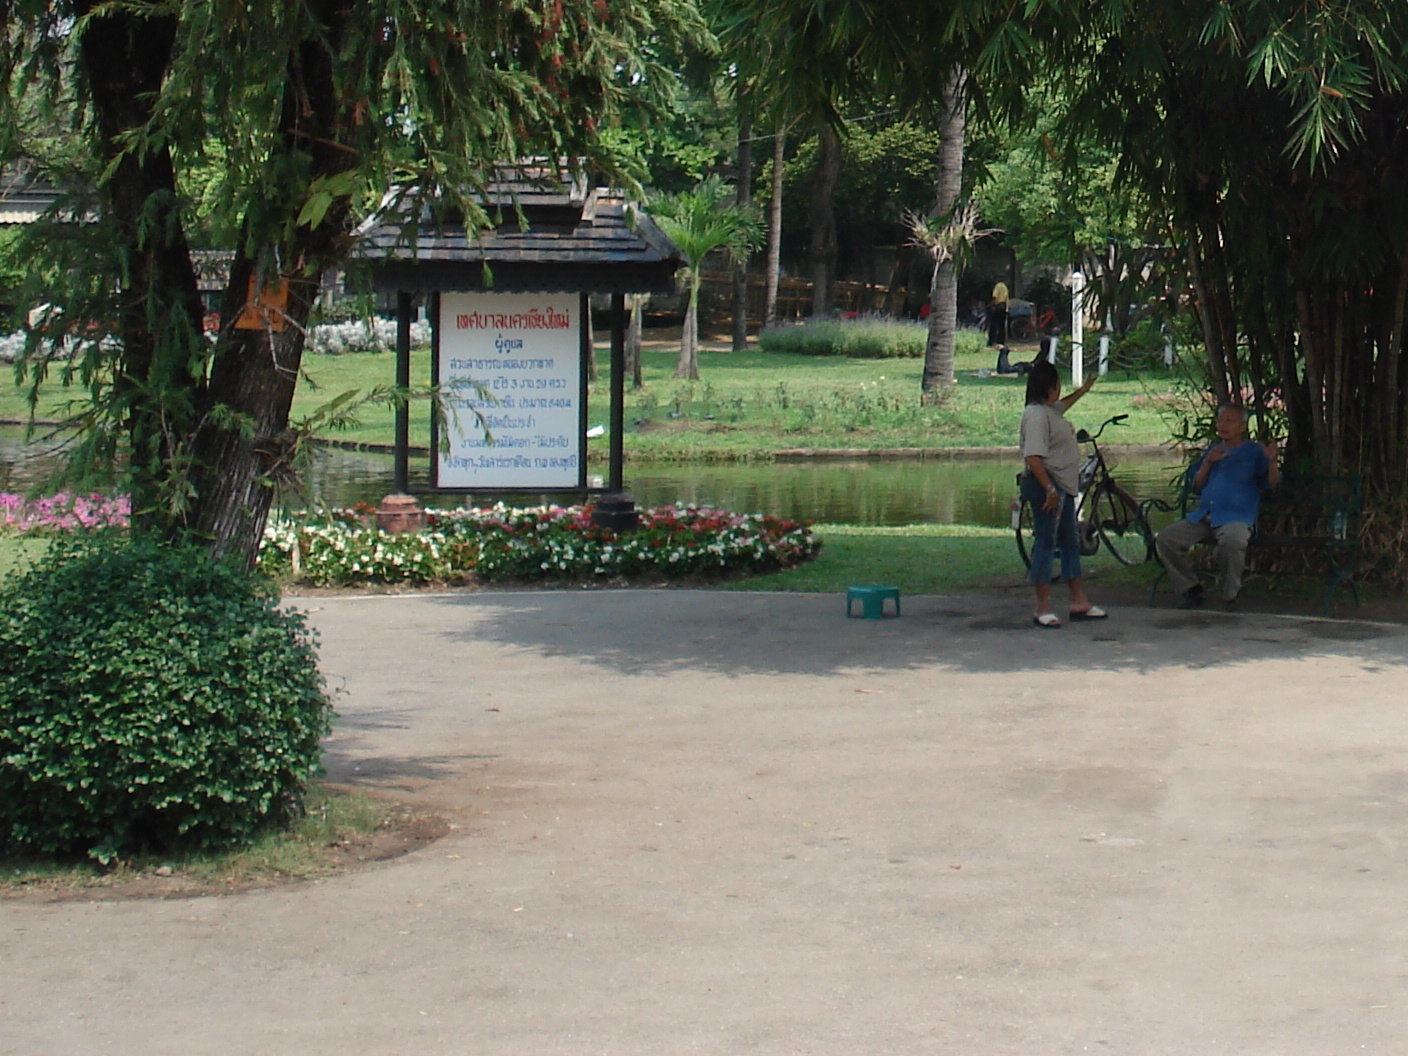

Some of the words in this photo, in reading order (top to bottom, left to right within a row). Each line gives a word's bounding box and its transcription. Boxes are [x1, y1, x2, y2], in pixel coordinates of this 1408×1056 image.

[456, 307, 569, 330] เทศบาลนครเชียงใหม่
[495, 333, 523, 353] ผู้ดูแล
